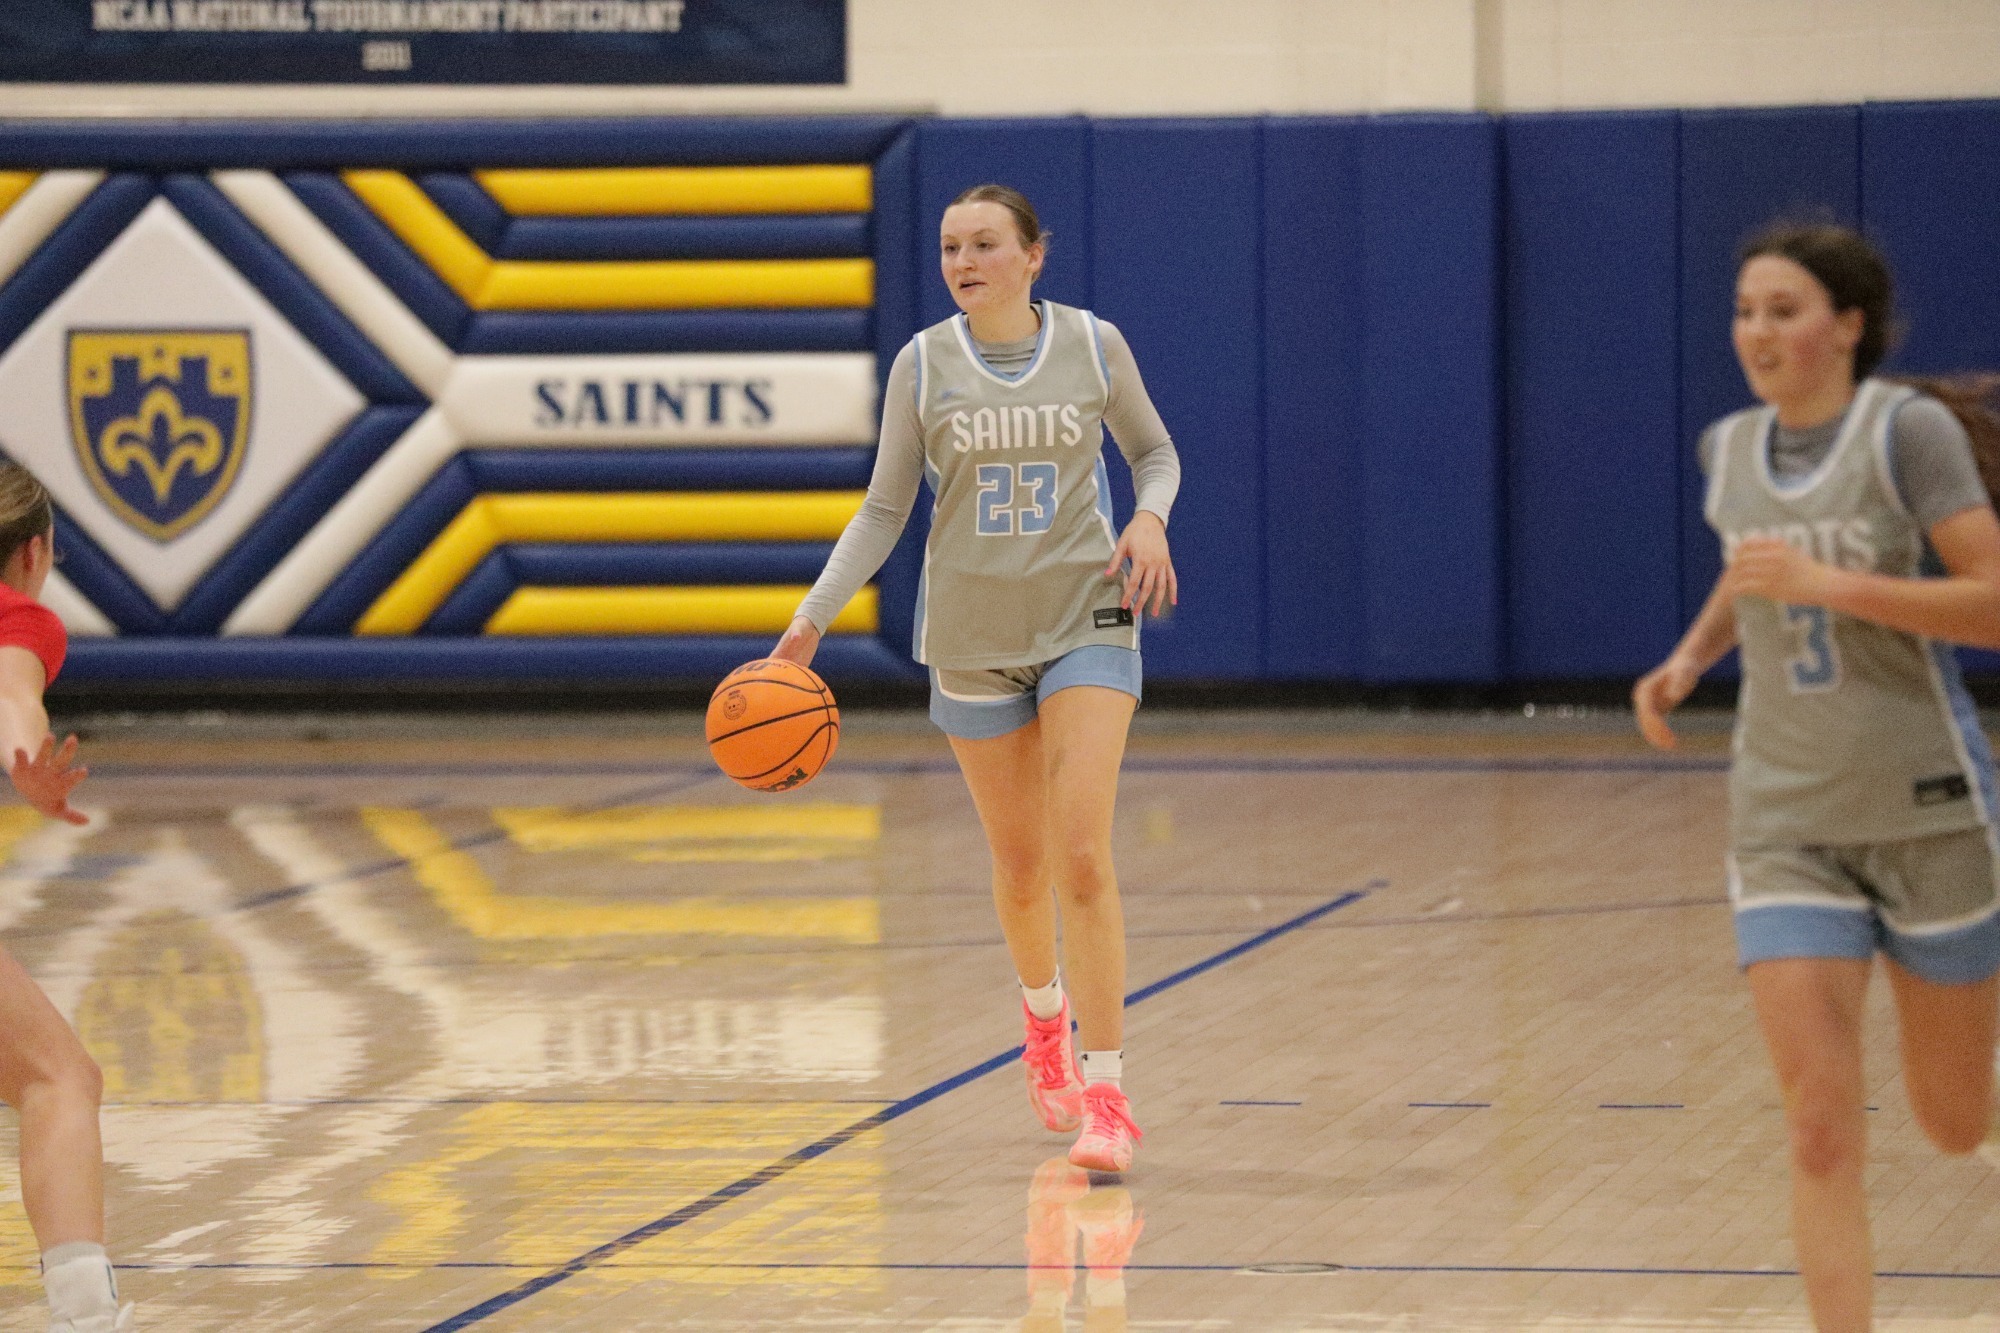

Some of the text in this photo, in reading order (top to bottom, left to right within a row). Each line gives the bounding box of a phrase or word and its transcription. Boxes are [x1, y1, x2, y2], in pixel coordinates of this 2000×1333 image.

[92, 0, 684, 32] NCAA NATIONAL TOURNAMENT PARTICIPANT
[534, 378, 772, 429] SAINTS
[951, 403, 1083, 453] SAINTS
[975, 461, 1059, 537] 23
[1785, 603, 1843, 694] 3
